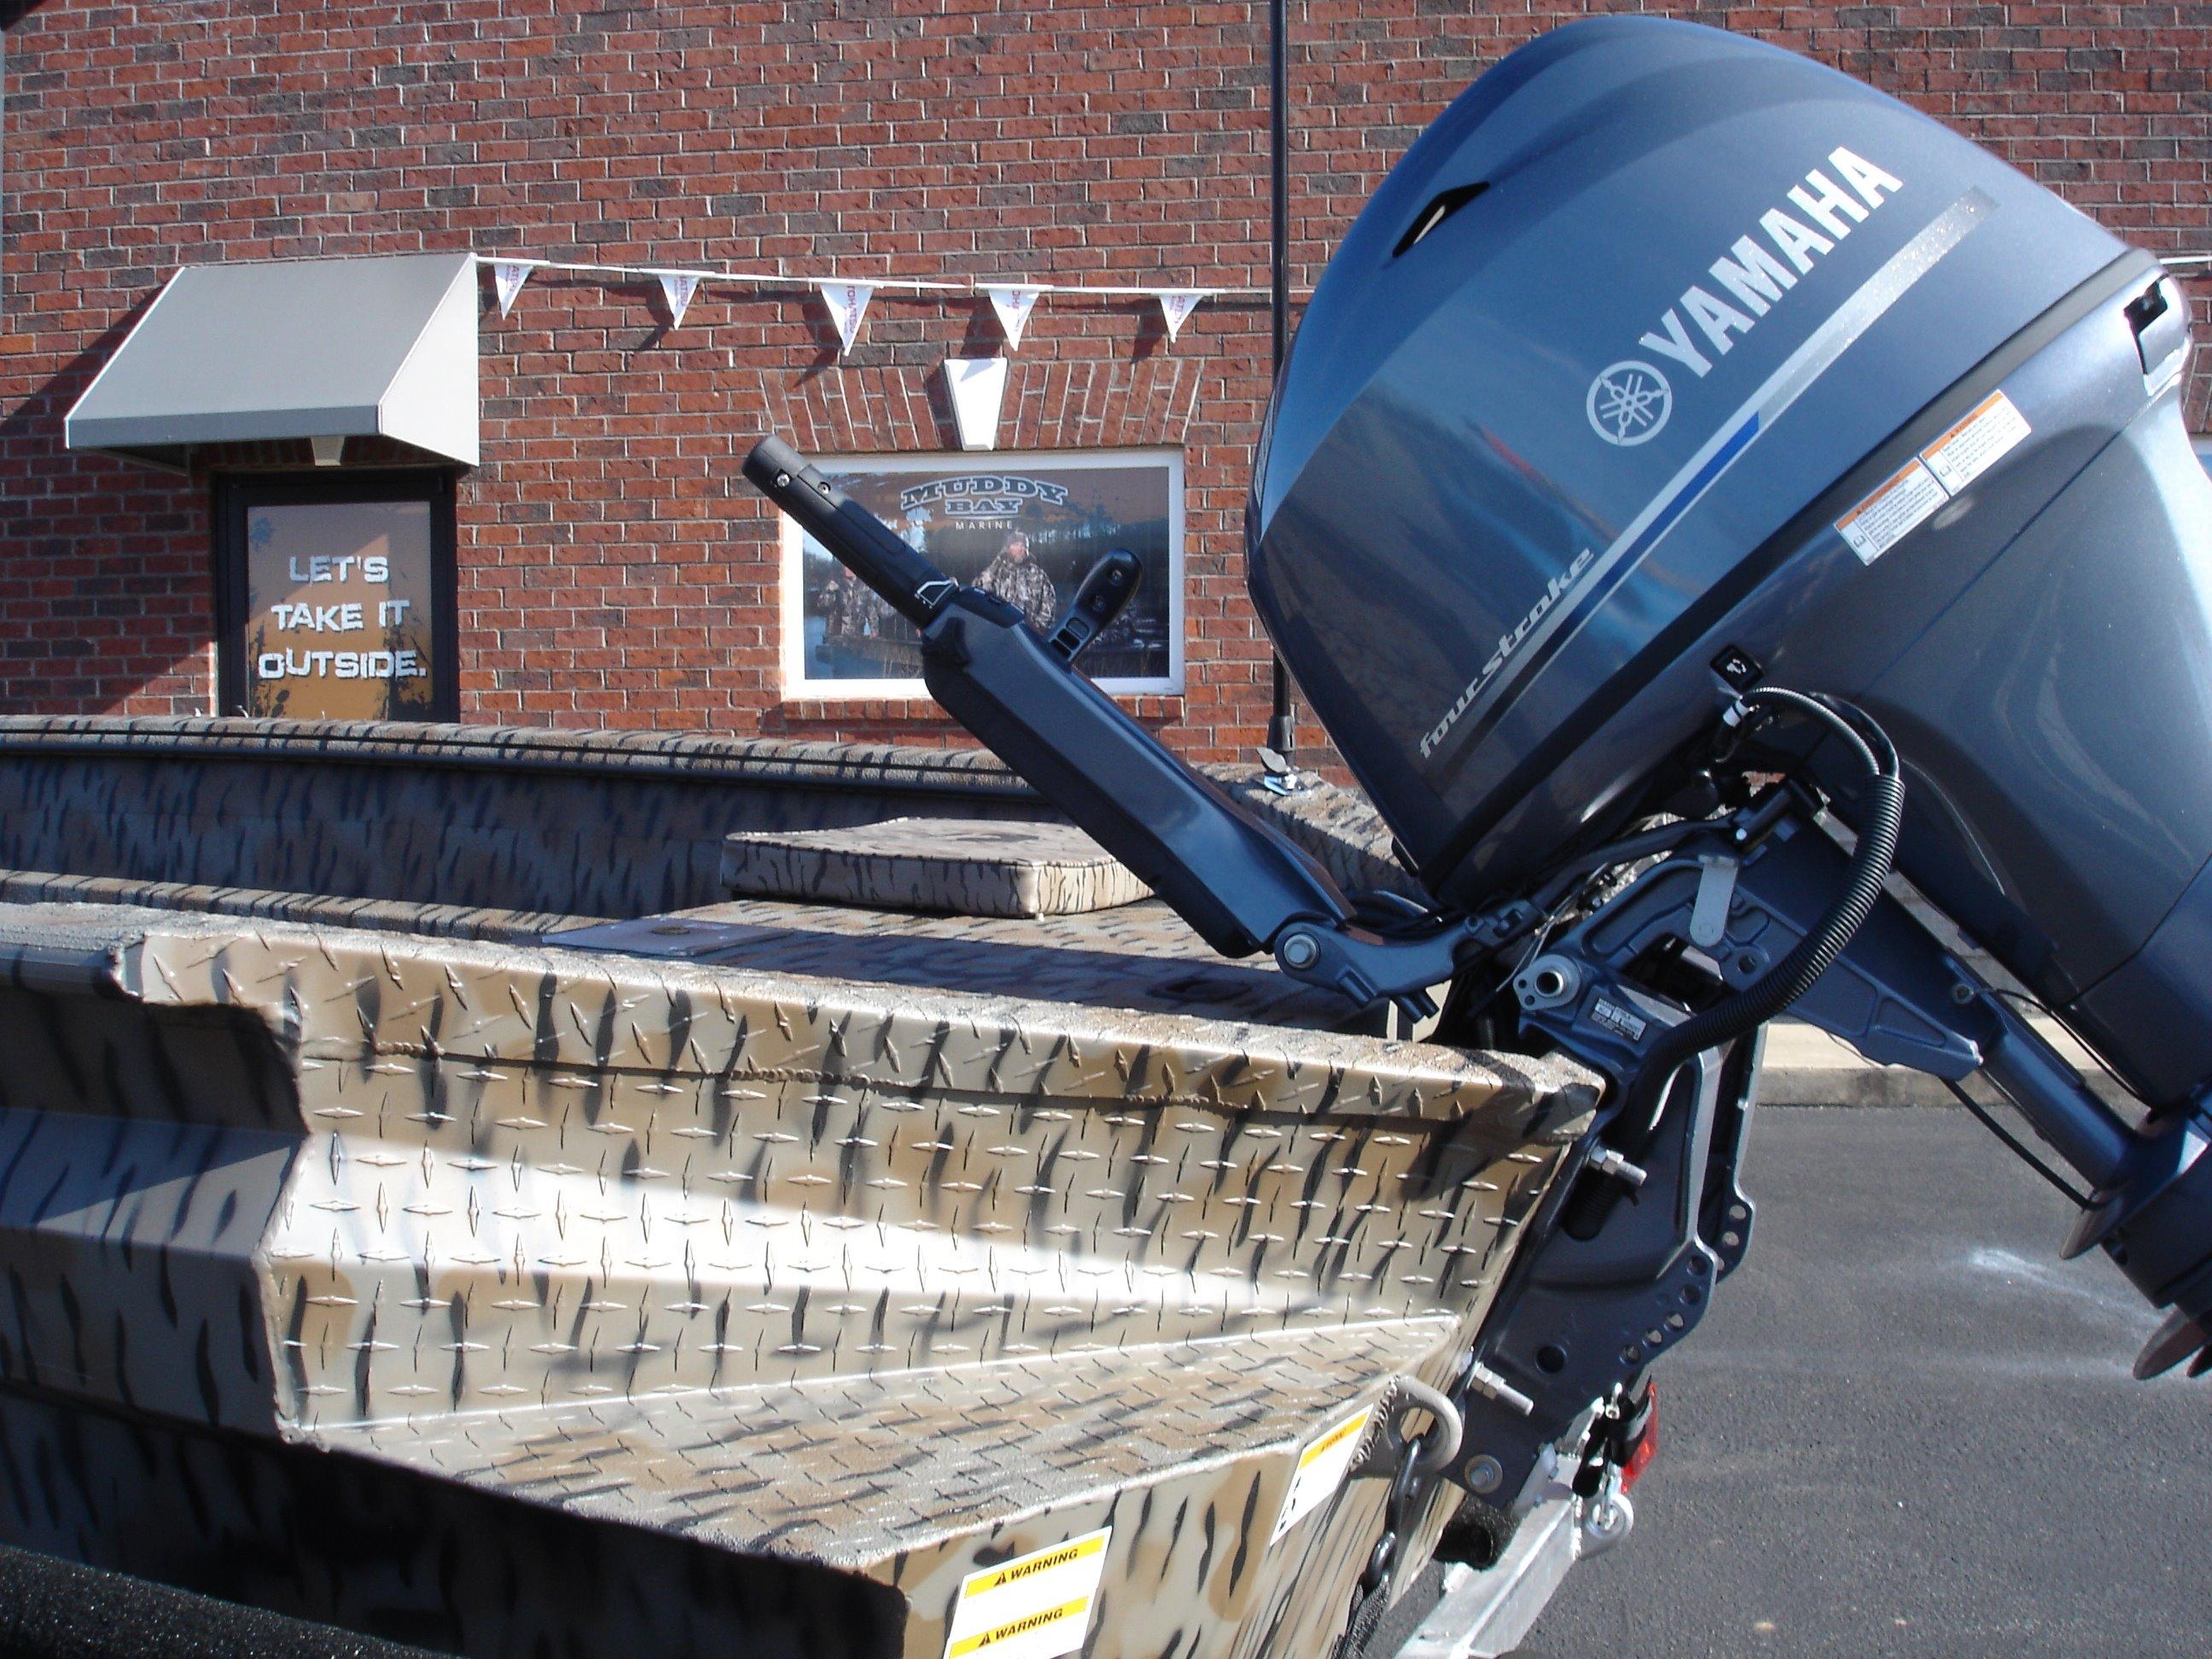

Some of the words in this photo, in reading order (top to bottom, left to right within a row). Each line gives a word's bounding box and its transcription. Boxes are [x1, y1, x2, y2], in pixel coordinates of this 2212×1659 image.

[1638, 146, 1904, 379] YAMAHA
[900, 474, 1068, 510] MUDDY
[945, 498, 1023, 515] BAY
[955, 521, 1014, 531] MARINE
[288, 556, 389, 584] LET'S
[270, 602, 364, 632] TAKE
[378, 599, 410, 628] IT
[258, 647, 427, 679] OUTSIDE.
[1010, 1548, 1079, 1581] WARNING
[995, 1608, 1063, 1641] WARNING
